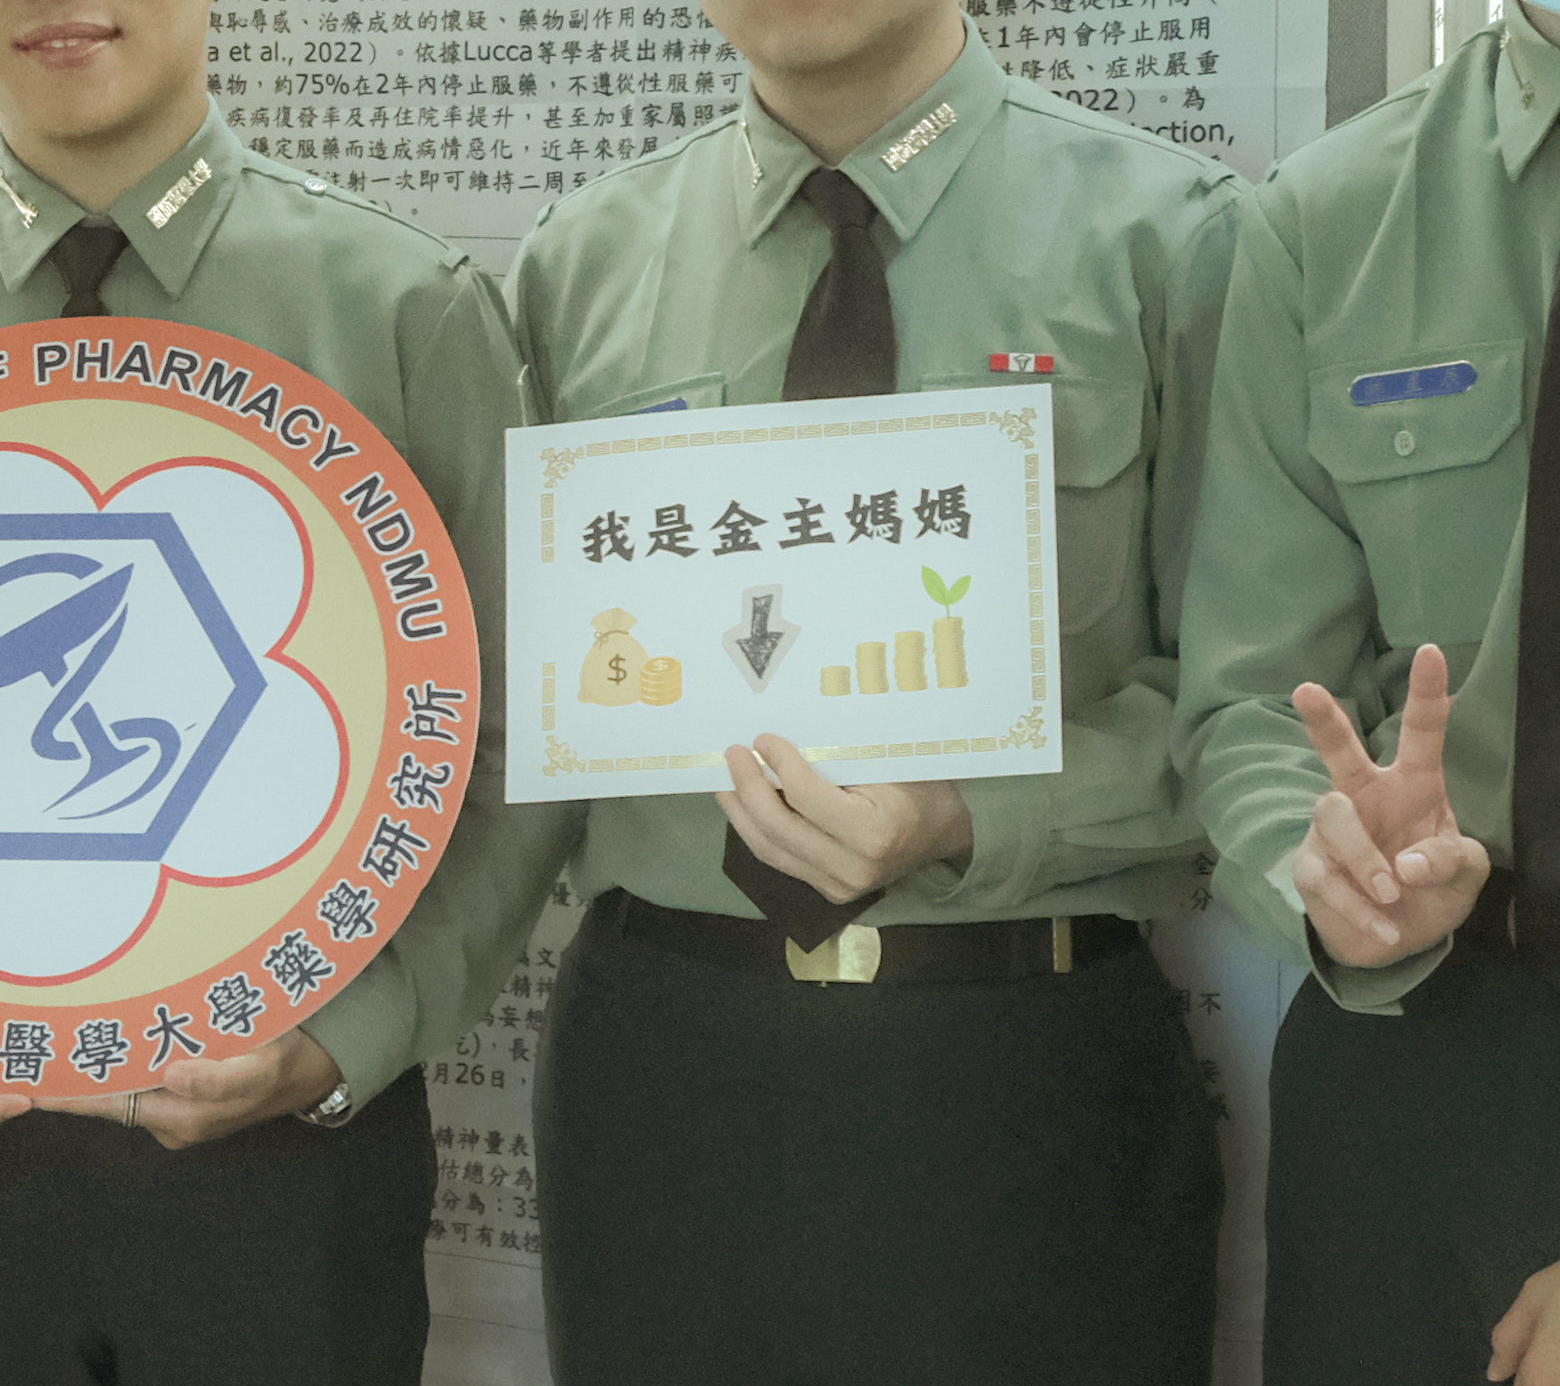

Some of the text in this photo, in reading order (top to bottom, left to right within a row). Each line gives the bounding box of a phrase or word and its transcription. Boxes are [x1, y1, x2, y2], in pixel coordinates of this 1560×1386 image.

[230, 43, 252, 62] et
[260, 41, 293, 67] al.,
[33, 340, 358, 470] PHARMACY
[342, 474, 448, 644] NDMU
[581, 483, 972, 564] 我是金主媽媽
